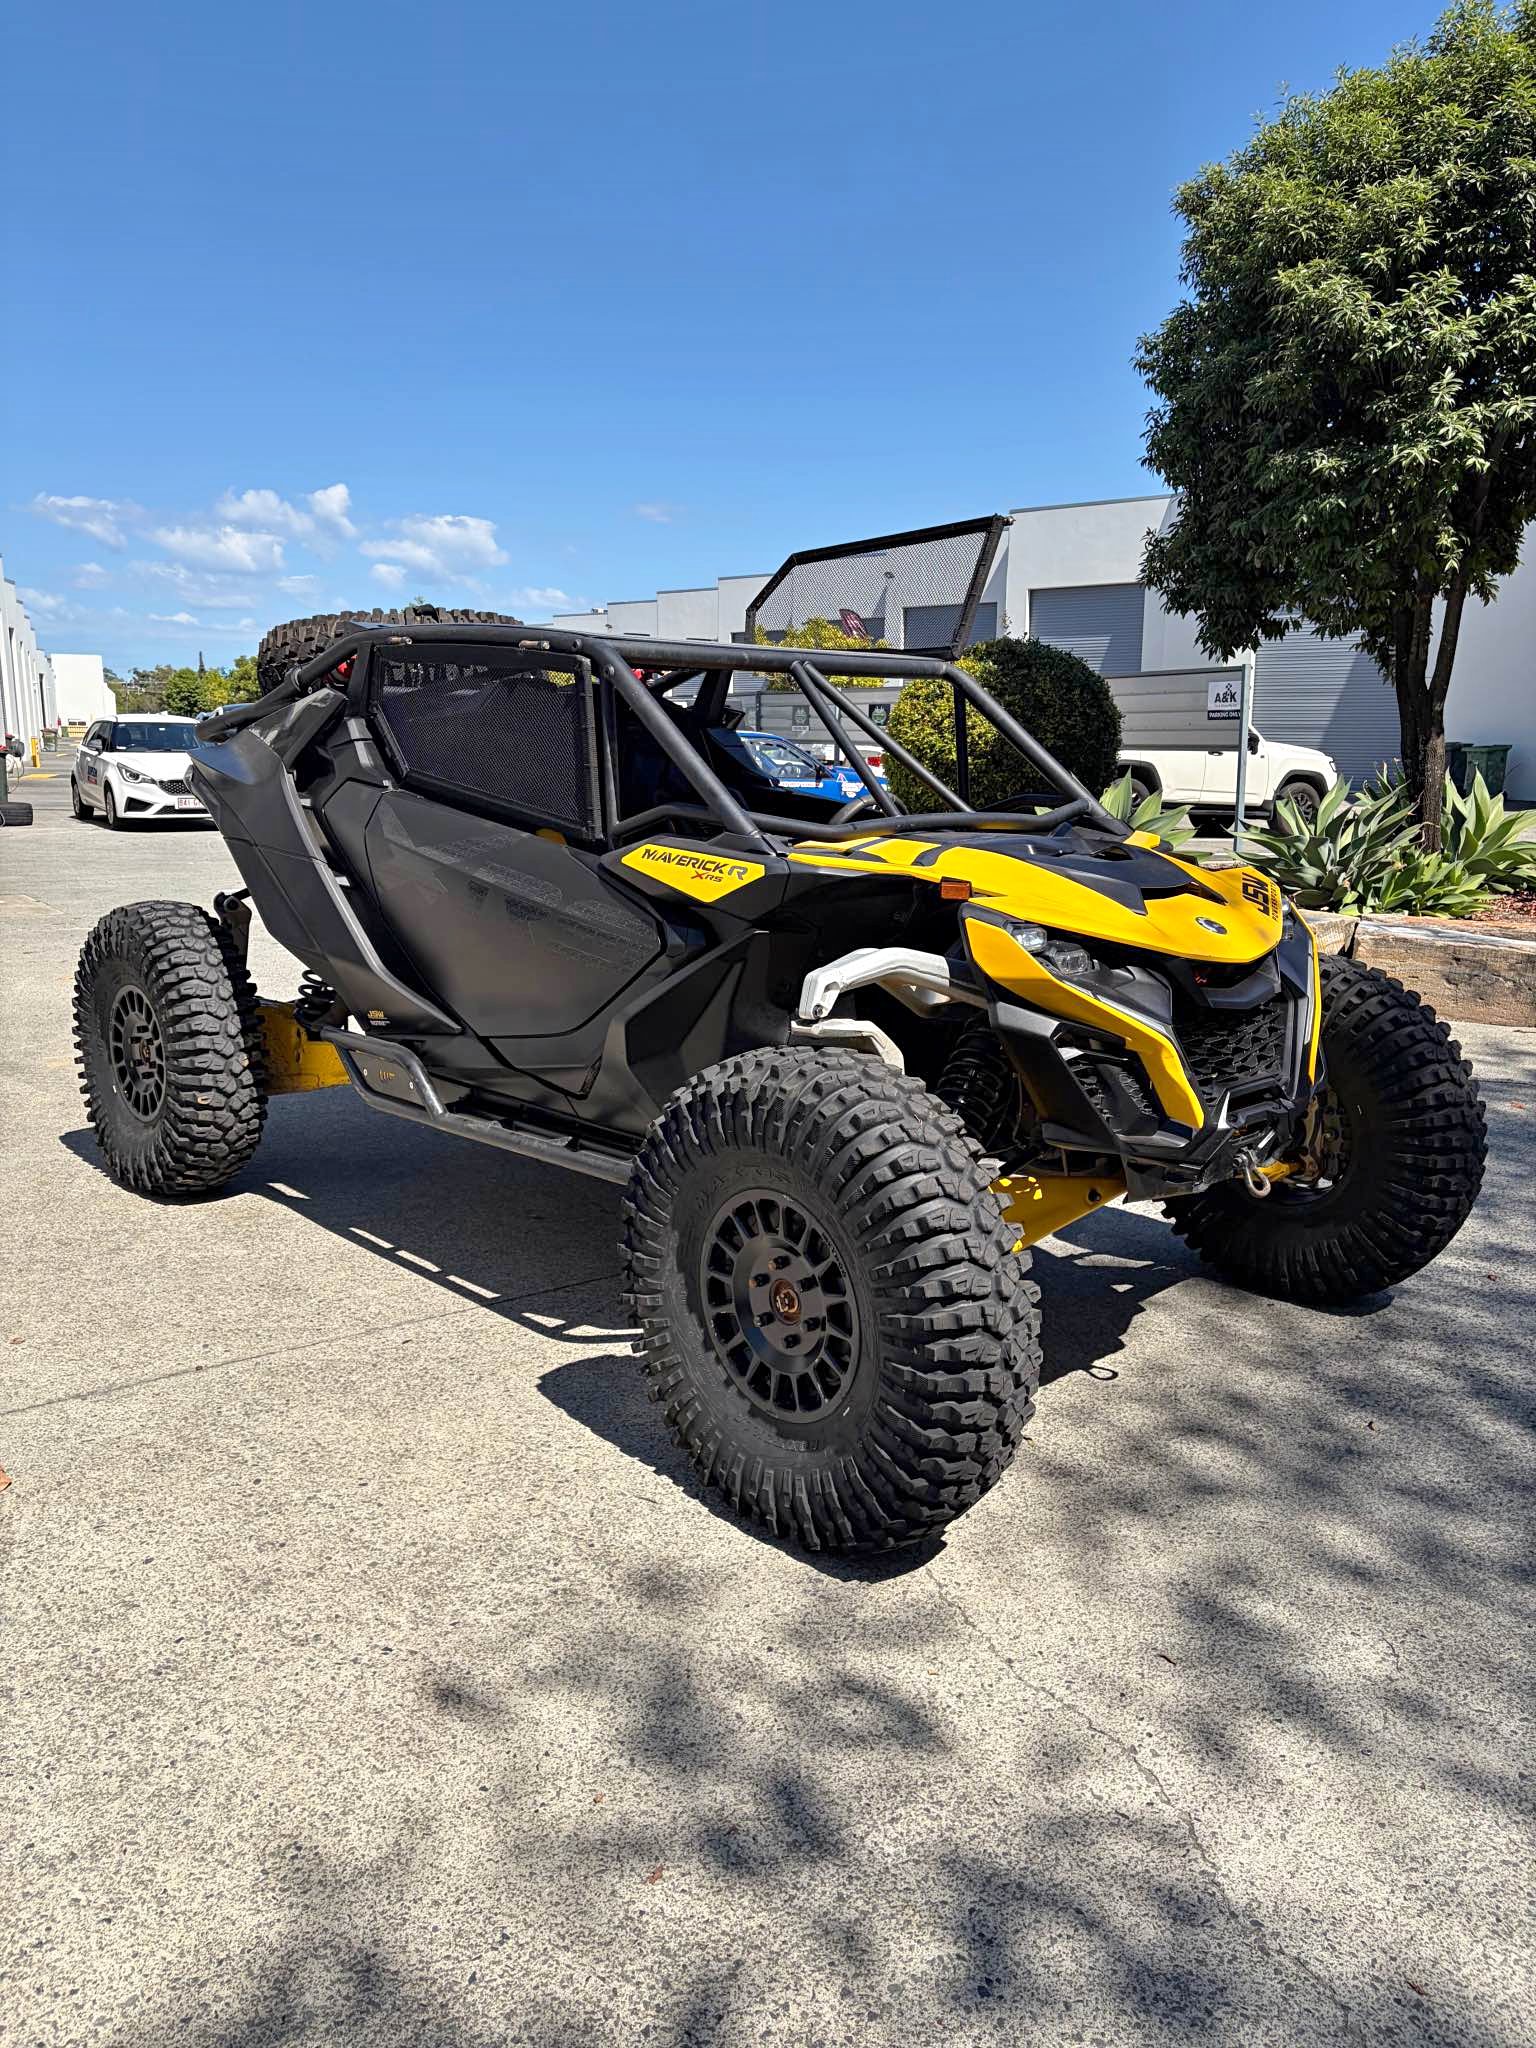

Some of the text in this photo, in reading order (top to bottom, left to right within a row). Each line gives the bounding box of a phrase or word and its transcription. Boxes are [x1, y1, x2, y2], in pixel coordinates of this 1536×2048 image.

[1214, 690, 1237, 703] A&K
[641, 848, 749, 881] MAVERICK R
